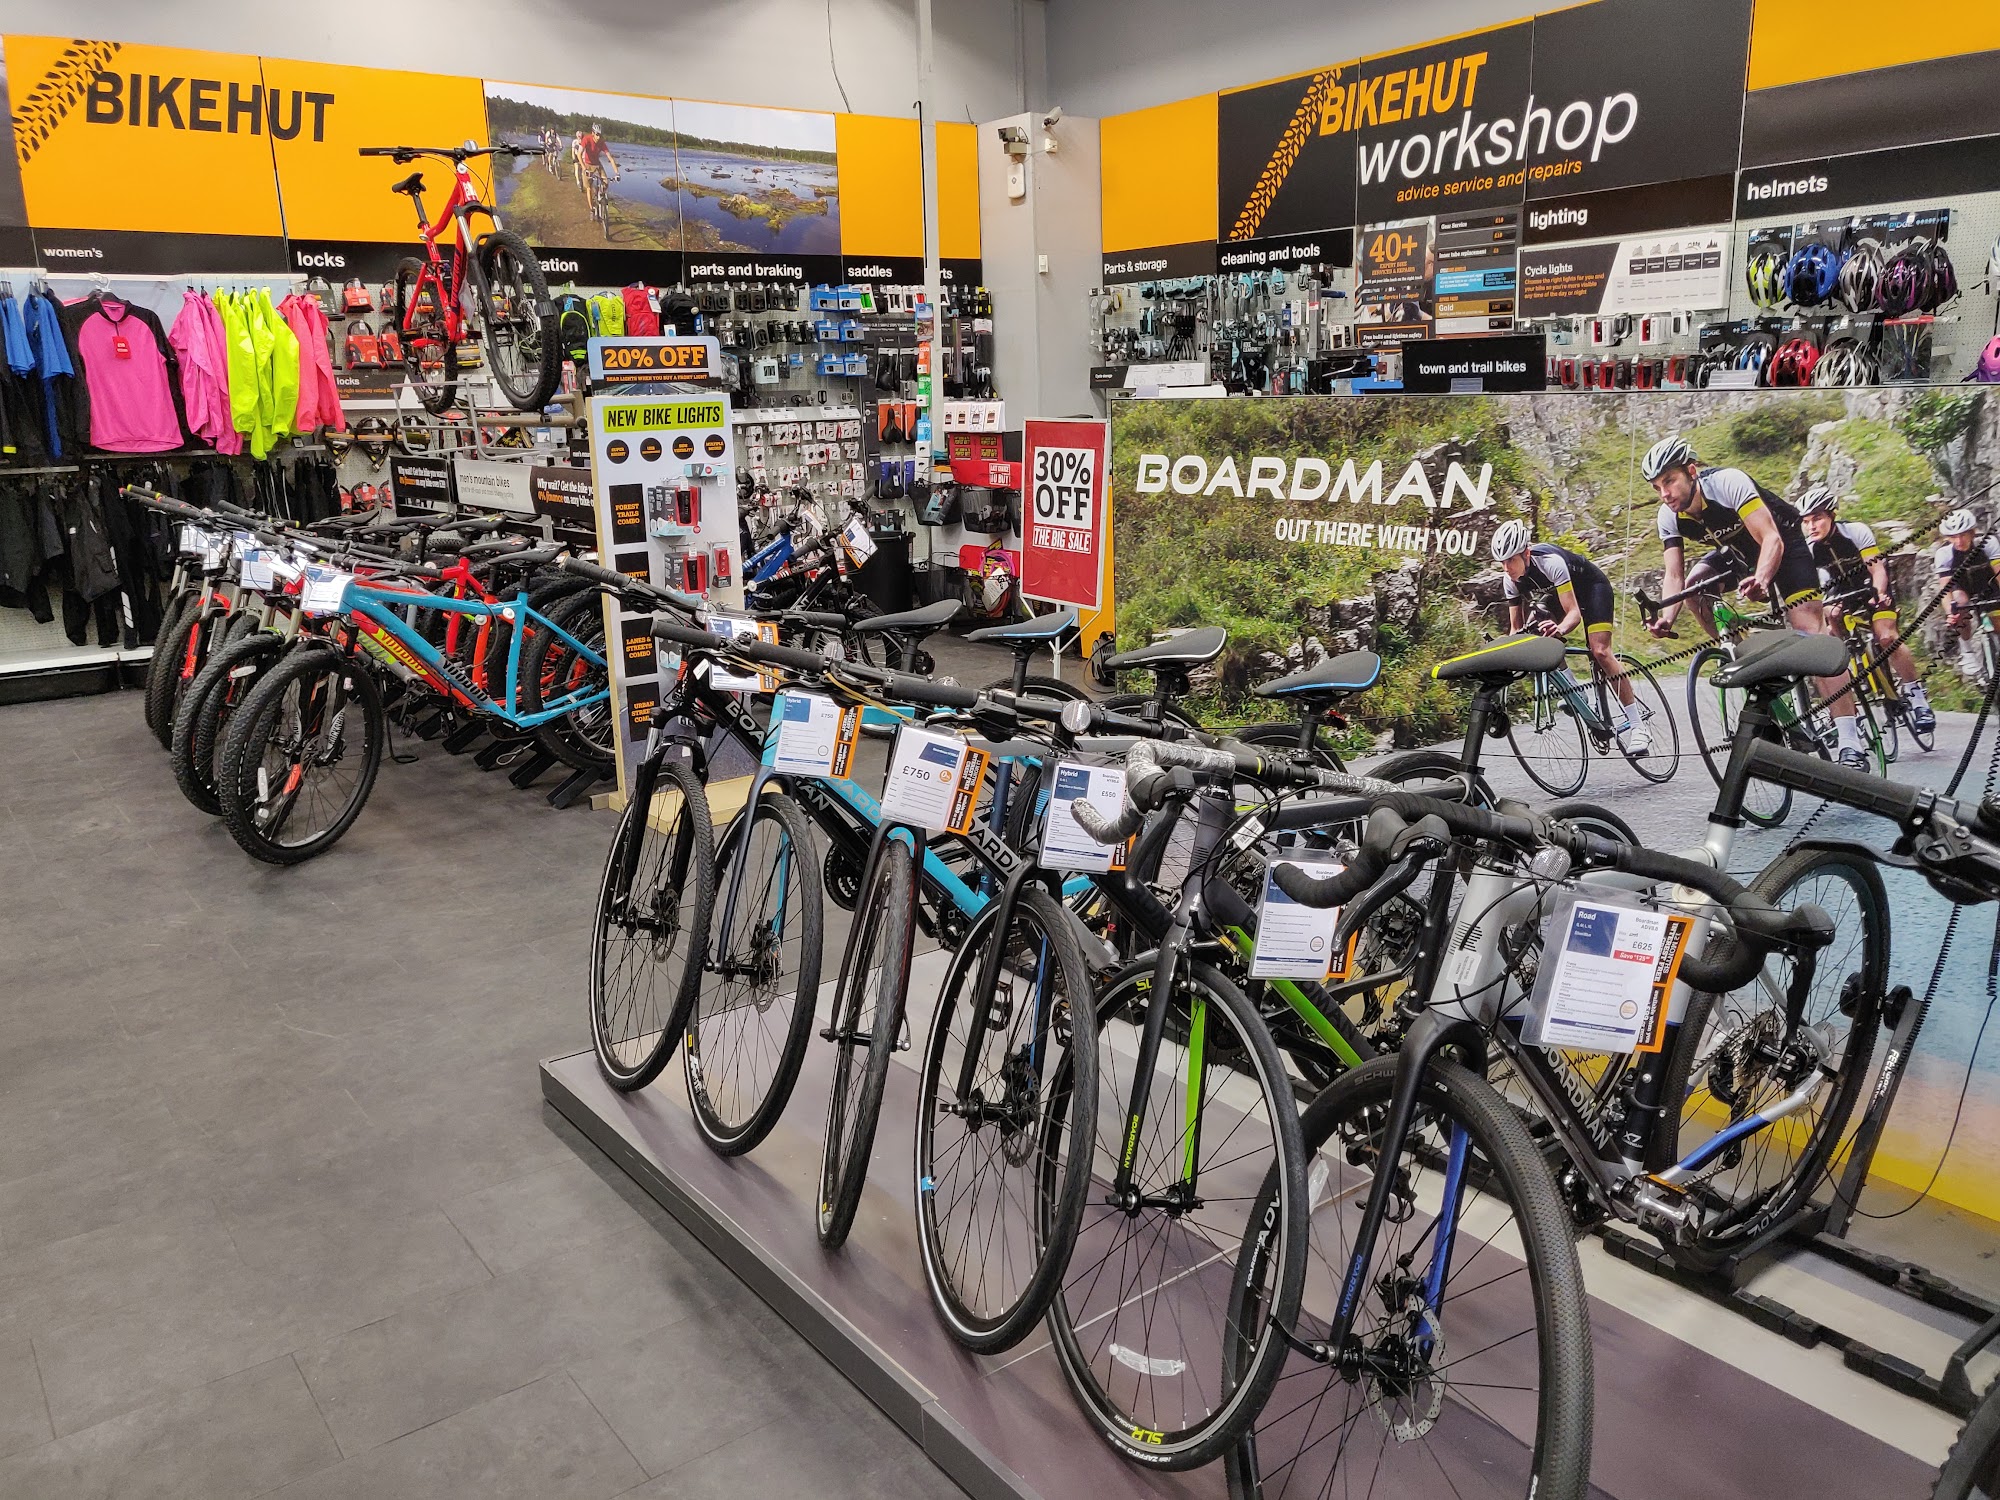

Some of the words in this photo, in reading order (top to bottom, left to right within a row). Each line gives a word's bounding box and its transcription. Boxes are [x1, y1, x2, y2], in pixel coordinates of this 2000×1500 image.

[1319, 51, 1487, 136] BIKEHUT
[86, 70, 335, 142] BIKEHUT
[1360, 92, 1638, 185] workshop
[1396, 186, 1439, 202] advice
[1444, 175, 1492, 195] service
[1497, 169, 1525, 186] and
[1528, 160, 1582, 181] repairs
[1747, 176, 1828, 200] helmets
[1530, 207, 1588, 228] lighting
[43, 247, 103, 259] women's
[1221, 250, 1266, 266] cleaning
[1269, 248, 1289, 261] and
[1292, 244, 1320, 259] tools
[1369, 232, 1418, 263] 40+
[297, 252, 345, 268] locks
[1104, 262, 1126, 275] Parts
[1127, 262, 1133, 272] &
[1134, 259, 1167, 273] storage
[690, 263, 731, 279] parts
[734, 263, 752, 277] and
[755, 263, 803, 280] braking
[847, 264, 892, 278] saddles
[1525, 265, 1548, 276] Cycle
[1549, 263, 1573, 274] lights
[1439, 304, 1454, 312] Gold
[604, 348, 654, 368] 20%
[659, 346, 705, 367] OFF
[1419, 363, 1446, 375] town
[1448, 362, 1468, 374] and
[1471, 361, 1493, 373] trail
[1496, 360, 1526, 373] bikes
[336, 376, 360, 385] locks
[608, 409, 637, 428] NEW
[643, 407, 672, 426] BIKE
[677, 406, 720, 424] LIGHTS
[1035, 450, 1091, 485] 30%
[460, 474, 473, 485] men's
[474, 475, 495, 487] mountain
[496, 476, 510, 488] bikes
[537, 478, 547, 490] Why
[548, 480, 560, 491] wait?
[561, 481, 569, 491] Get
[578, 483, 588, 494] bike
[1136, 454, 1495, 509] BOARDMAN
[546, 492, 563, 503] finance
[579, 496, 590, 506] bike
[615, 503, 639, 511] FOREST
[1036, 484, 1090, 521] OFF
[617, 510, 639, 518] TRAILS
[617, 517, 641, 525] COMBO
[1034, 527, 1050, 544] THE
[1051, 529, 1065, 548] BIG
[1068, 533, 1091, 552] SALE
[1276, 518, 1312, 543] OUT
[1315, 520, 1374, 549] THERE
[1378, 524, 1430, 553] WITH
[1434, 529, 1477, 557] YOU
[626, 643, 652, 651] STREETS
[629, 650, 651, 659] COMBO
[633, 701, 654, 709] URBAN
[634, 714, 650, 723] COM
[902, 765, 931, 781] £750
[1060, 769, 1078, 778] Hybrid
[1101, 790, 1117, 798] £550
[1578, 911, 1597, 921] Road
[1635, 917, 1659, 925] Boardman
[1632, 941, 1653, 951] £625
[1662, 922, 1679, 960] INTEREST
[1663, 940, 1677, 974] MONTHS
[1653, 961, 1666, 982] FREE
[1137, 978, 1153, 992] SL
[1354, 1069, 1397, 1087] SCHW
[1123, 1114, 1139, 1169] BOARDMAN
[1341, 1254, 1363, 1317] BOARDMAN
[1131, 1425, 1165, 1445] SLR
